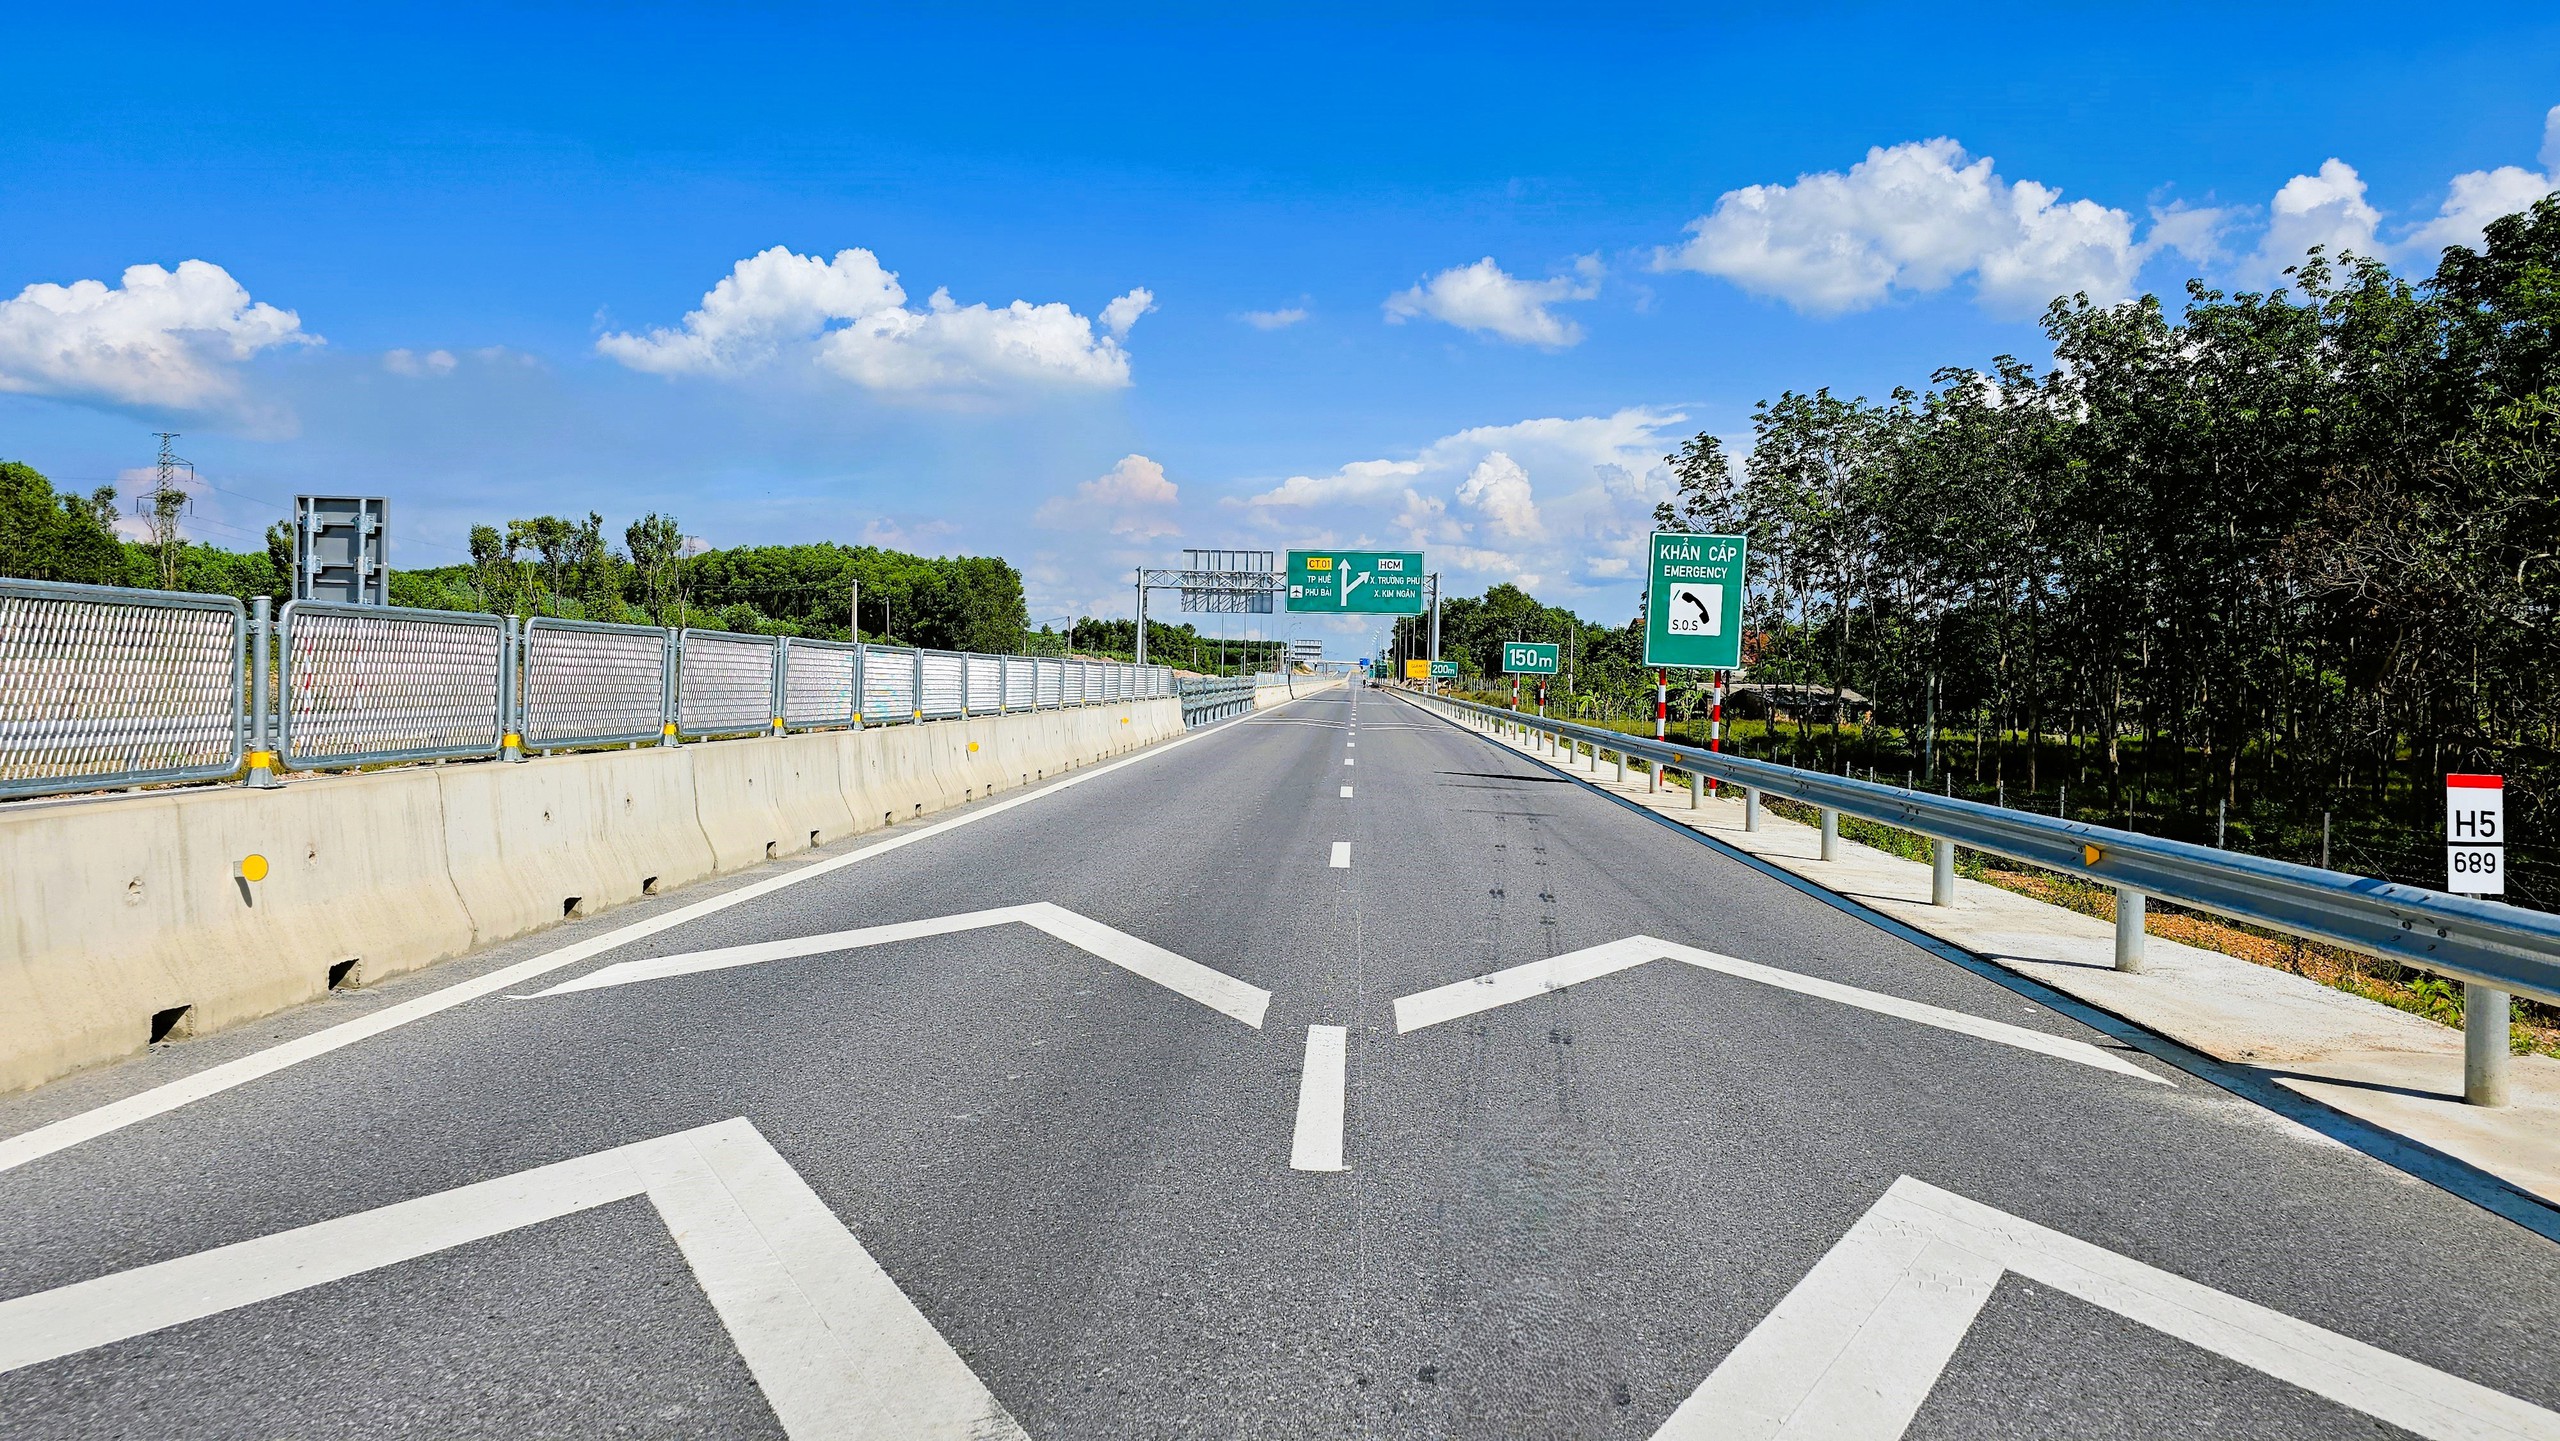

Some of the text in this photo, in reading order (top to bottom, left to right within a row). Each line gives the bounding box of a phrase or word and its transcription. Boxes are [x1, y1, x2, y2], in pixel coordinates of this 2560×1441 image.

[1660, 537, 1737, 562] KHẨN CẤP
[1309, 559, 1330, 568] CT.01
[1380, 561, 1401, 569] HCM
[1307, 572, 1332, 584] TP HUẾ
[1664, 565, 1728, 579] EMERGENCY
[1406, 575, 1420, 585] PHÚ
[1305, 586, 1332, 596] PHÚ BÀI
[1672, 619, 1698, 631] S.O.S
[2456, 810, 2495, 837] H5
[2454, 852, 2495, 873] 689
